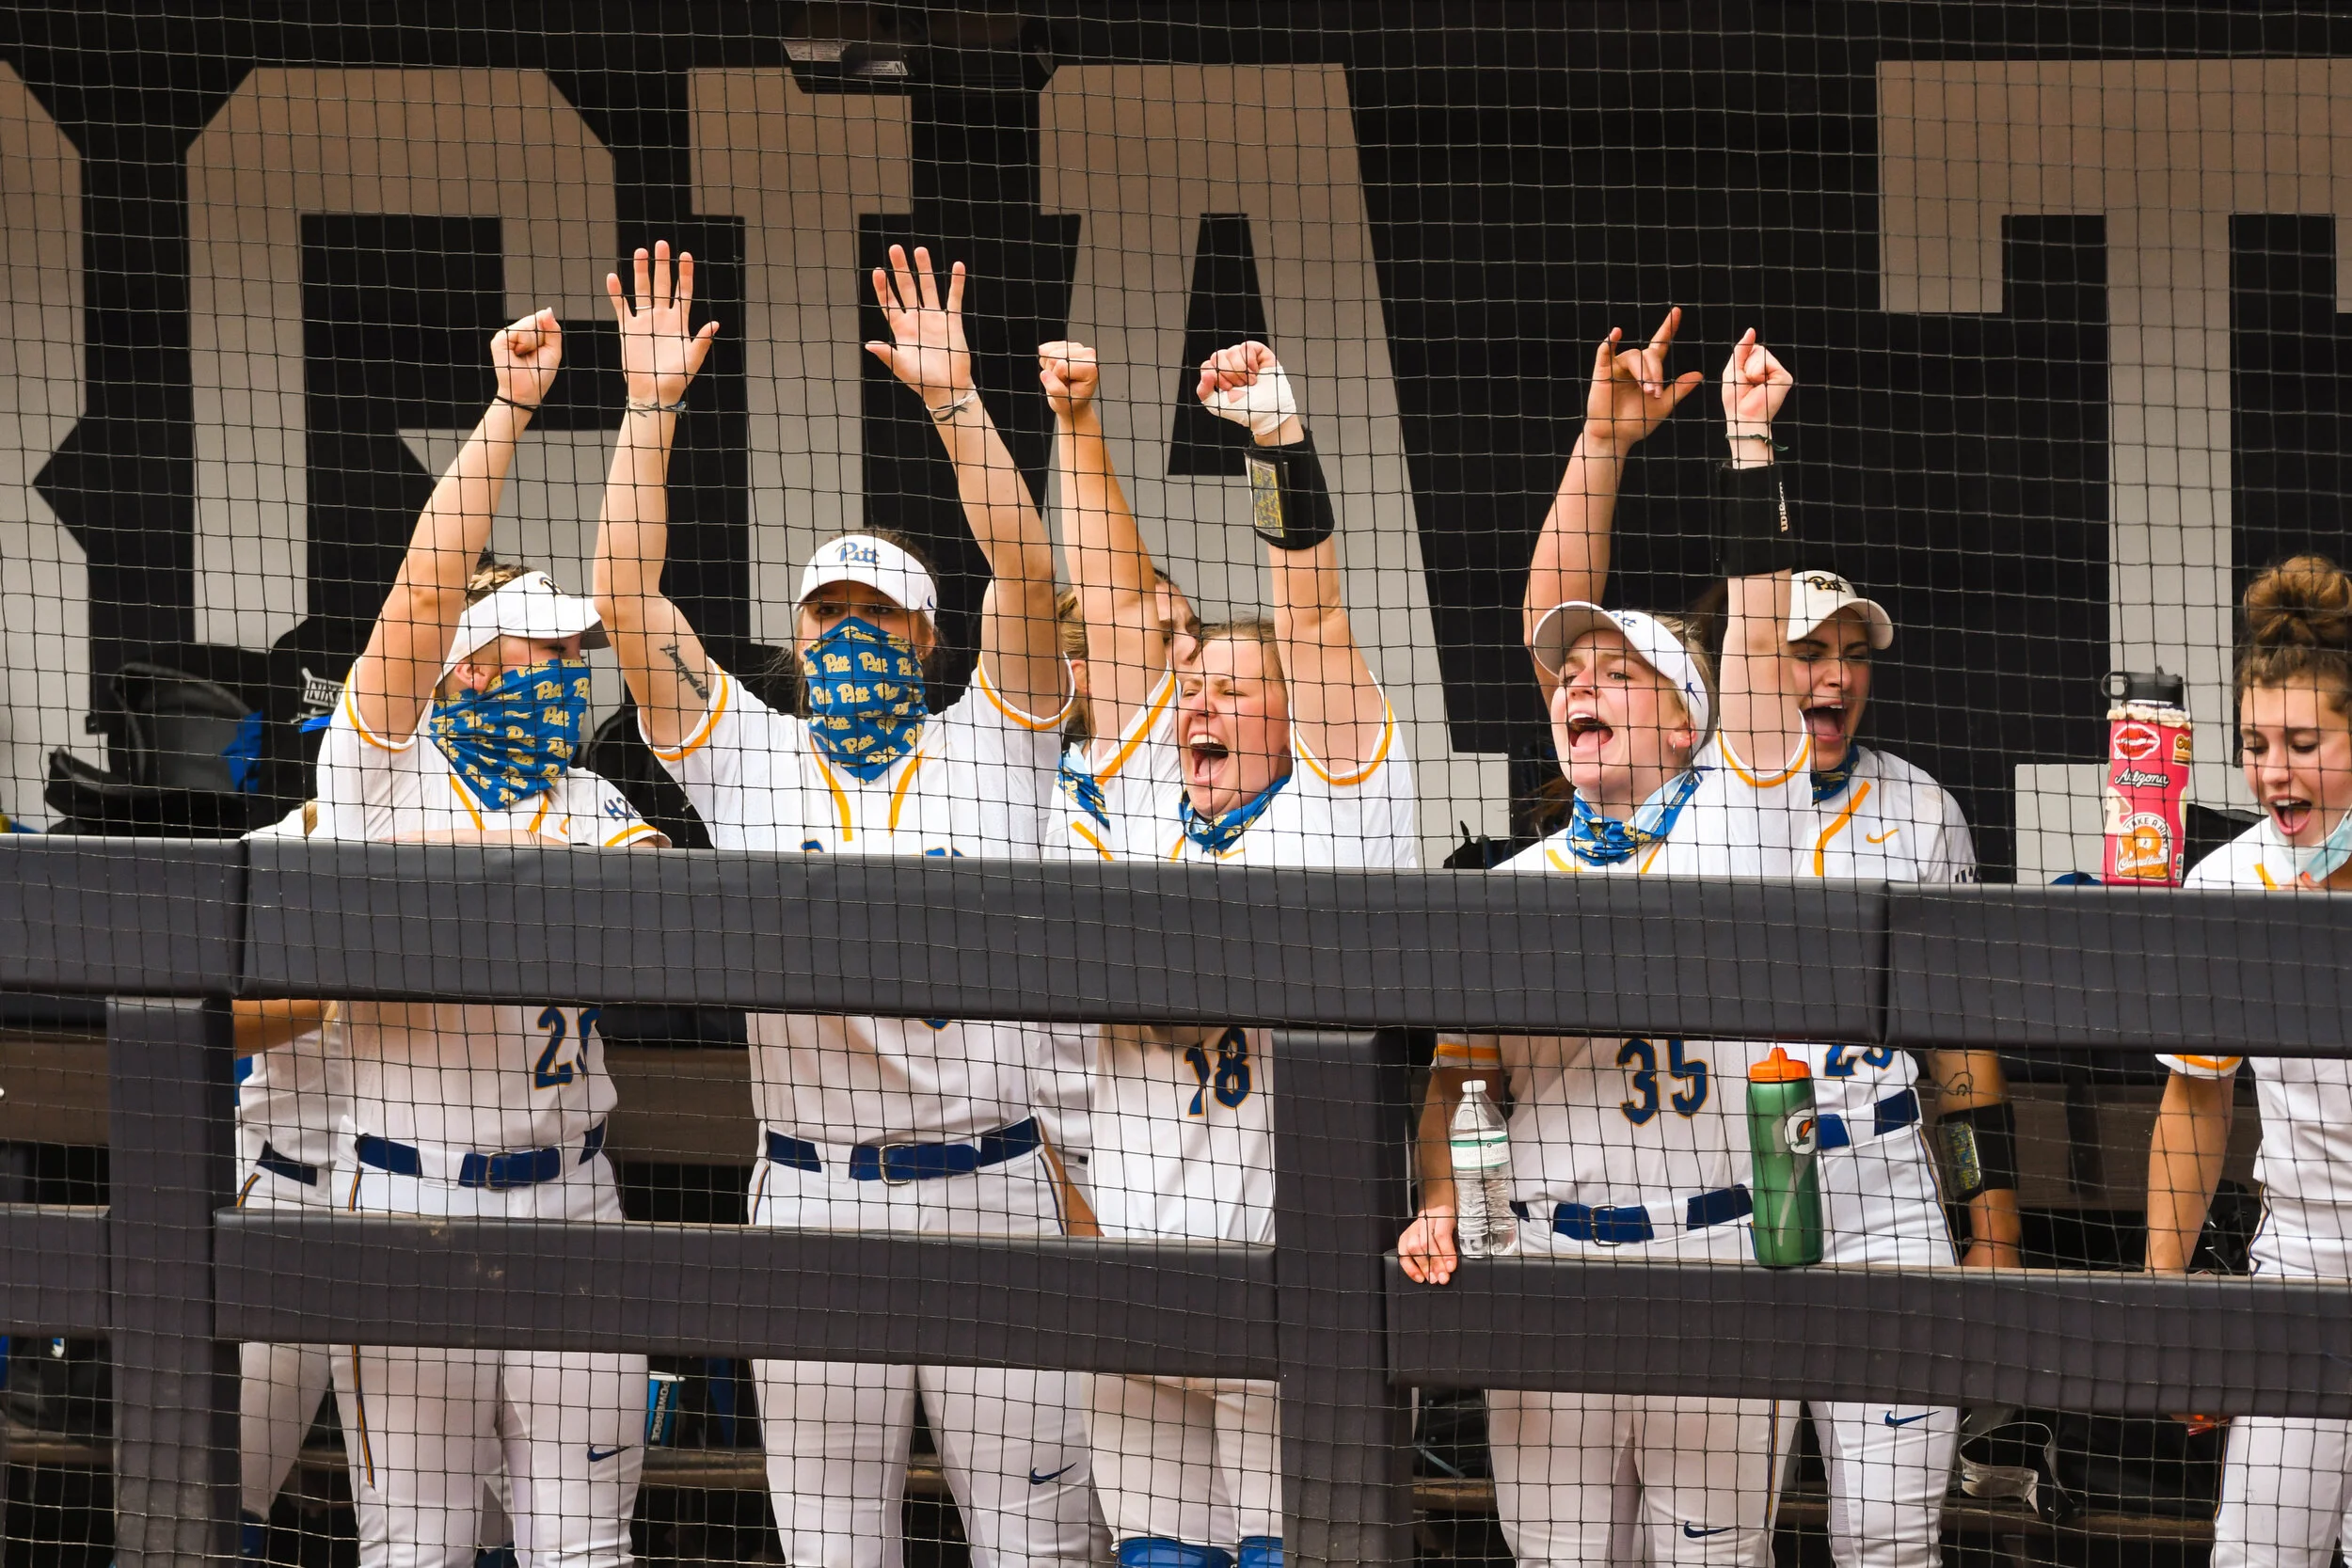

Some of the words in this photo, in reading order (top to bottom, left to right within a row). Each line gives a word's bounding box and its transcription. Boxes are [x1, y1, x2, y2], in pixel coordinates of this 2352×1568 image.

[835, 542, 881, 564] Pitt
[1806, 576, 1846, 593] Pitt
[823, 654, 851, 673] Pitt
[858, 652, 887, 673] Pitt
[533, 681, 564, 700] Pitt
[813, 685, 833, 705] Pitt
[836, 683, 871, 704] Pitt
[544, 706, 569, 726] Pitt
[841, 735, 875, 753] Pitt
[2115, 768, 2169, 788] Arizona
[2126, 817, 2150, 831] TAKE
[1184, 1027, 1253, 1117] 18
[1616, 1037, 1709, 1128] 35
[651, 1381, 671, 1441] POWERADE
